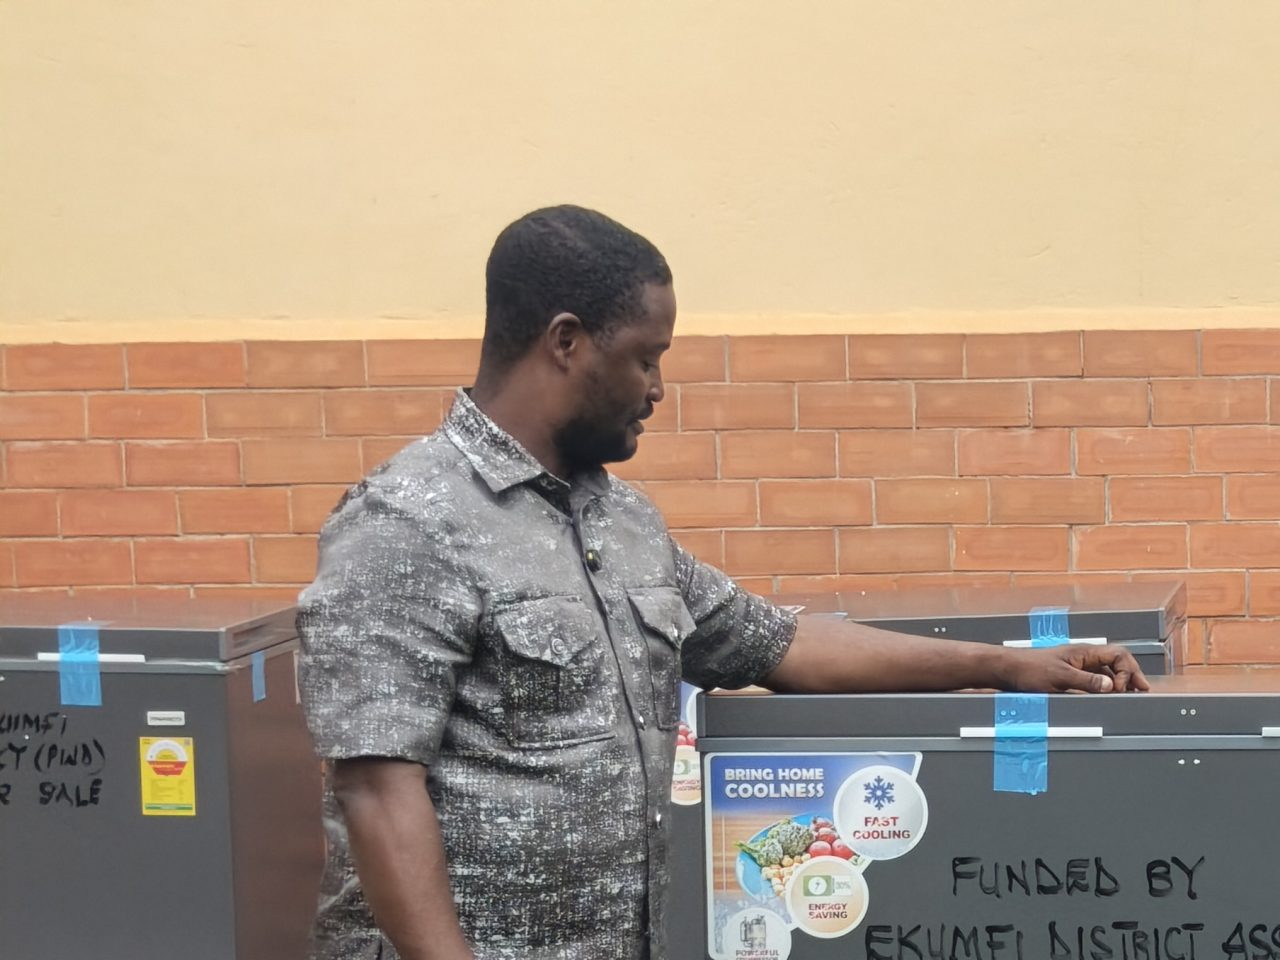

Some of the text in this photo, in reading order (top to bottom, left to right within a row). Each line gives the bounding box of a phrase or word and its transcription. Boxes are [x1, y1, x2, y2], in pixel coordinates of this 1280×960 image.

[33, 738, 106, 776] (PWD)
[724, 767, 825, 781] BRING HOME
[39, 778, 103, 808] SALE
[724, 782, 825, 798] COOLNESS
[864, 816, 900, 827] FAST
[853, 829, 911, 840] COOLING
[952, 856, 1205, 900] FUNDED BY
[808, 903, 848, 911] ENERGY
[808, 911, 848, 919] SAVING
